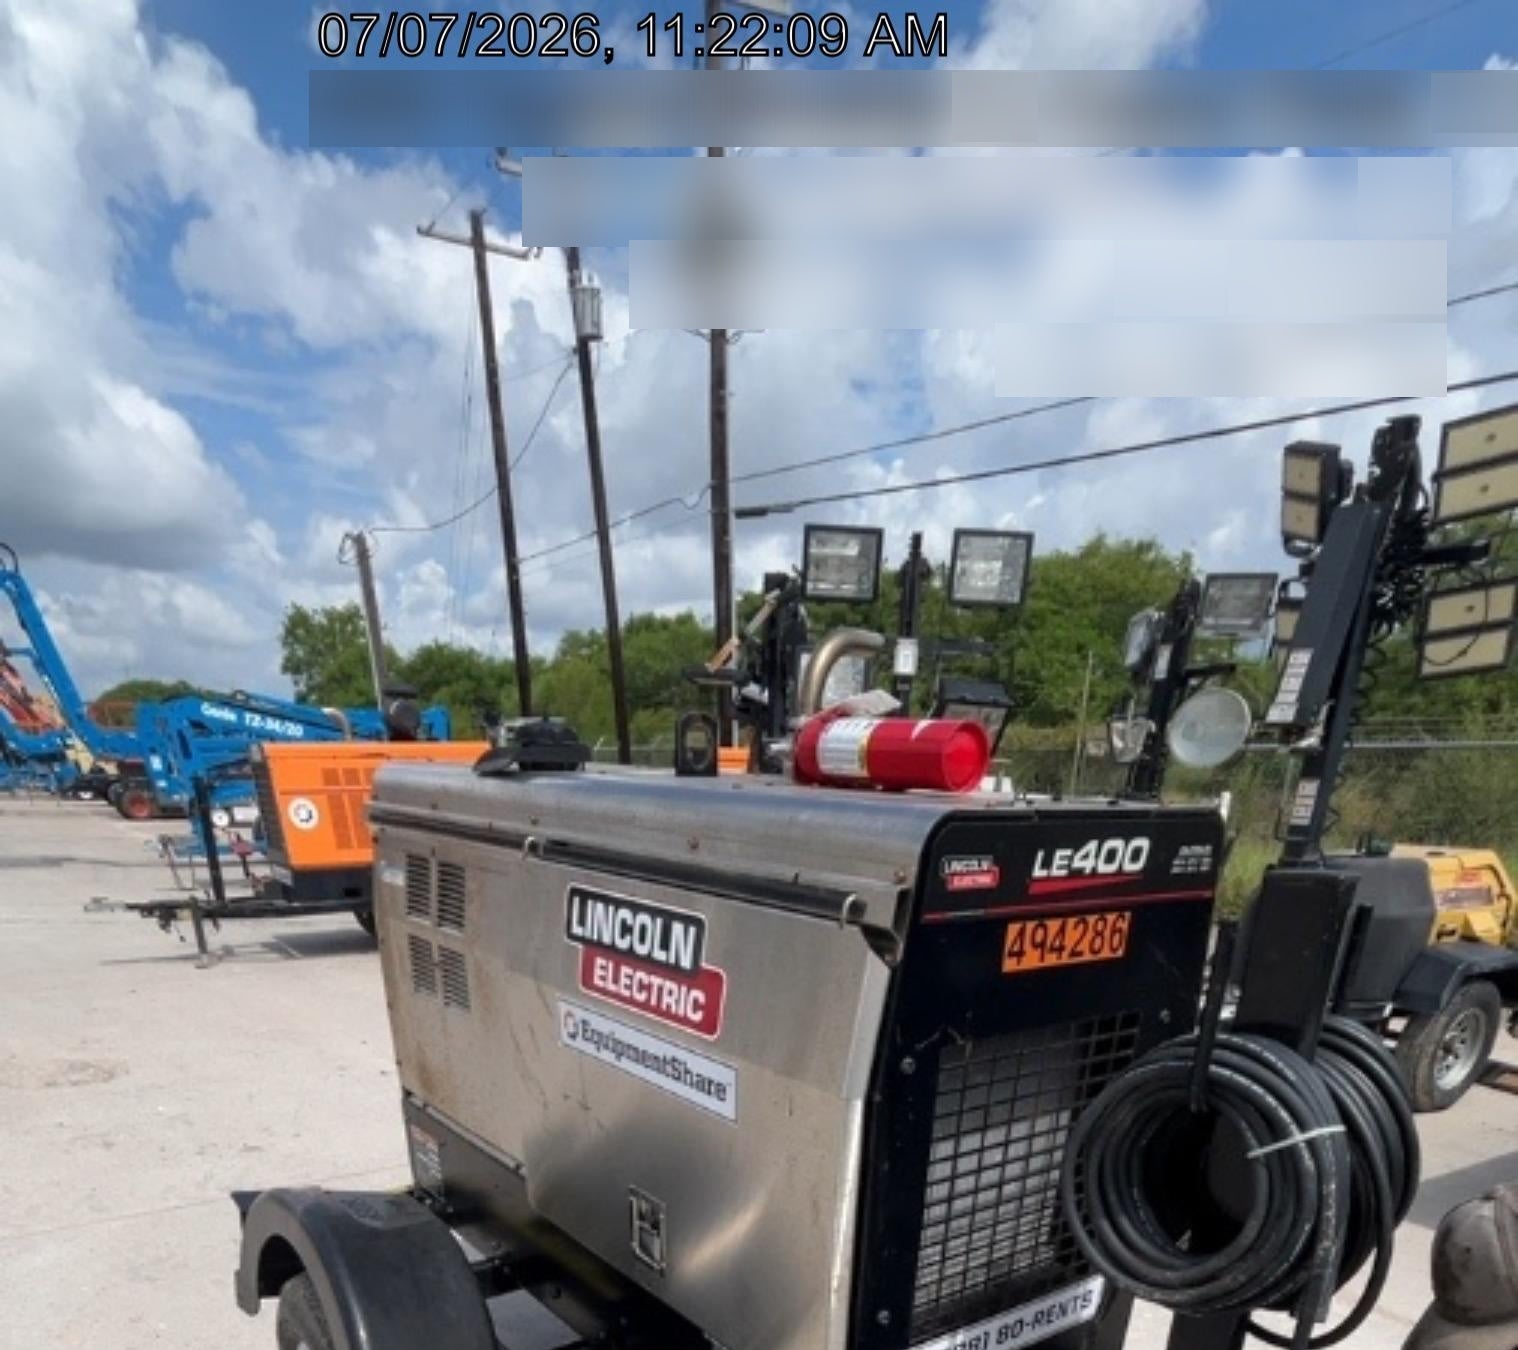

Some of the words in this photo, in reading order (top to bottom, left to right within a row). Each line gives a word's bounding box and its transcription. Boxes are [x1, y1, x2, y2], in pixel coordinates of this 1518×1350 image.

[943, 858, 991, 875] LINCOLN
[1031, 836, 1150, 878] LE400
[571, 896, 697, 970] LINCOLN
[1007, 913, 1126, 965] 494286
[593, 956, 706, 1022] ELECTRIC
[580, 1018, 728, 1102] EquipmentShare
[996, 1289, 1093, 1344] 80-RENTS
